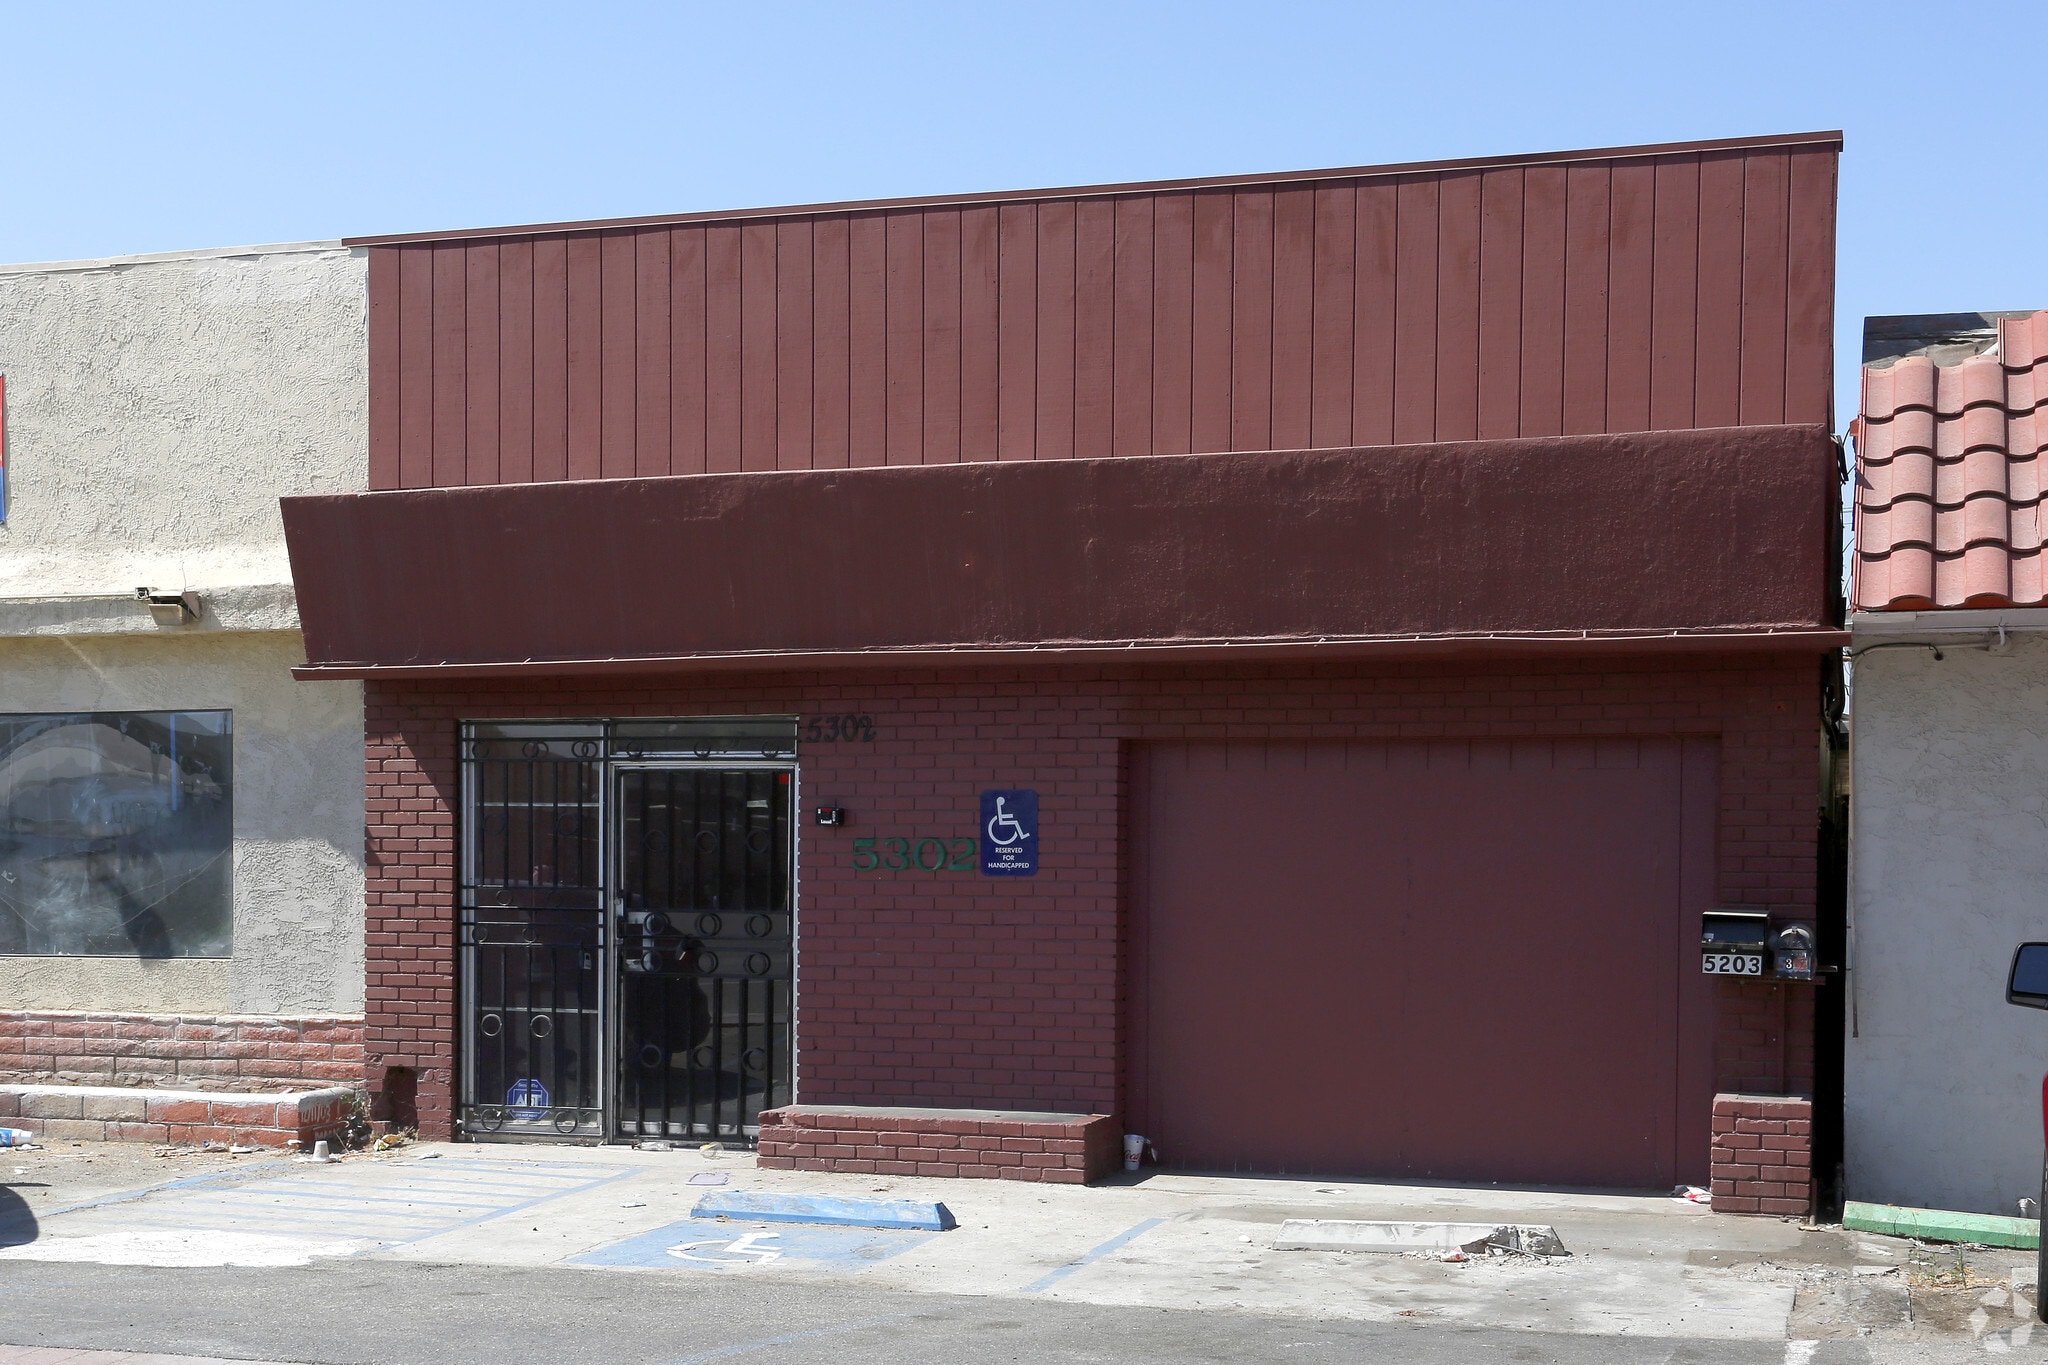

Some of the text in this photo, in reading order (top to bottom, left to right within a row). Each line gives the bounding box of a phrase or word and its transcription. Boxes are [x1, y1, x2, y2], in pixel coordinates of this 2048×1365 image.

[806, 714, 877, 743] 5302
[852, 837, 977, 872] 5302
[1704, 955, 1760, 974] 5203
